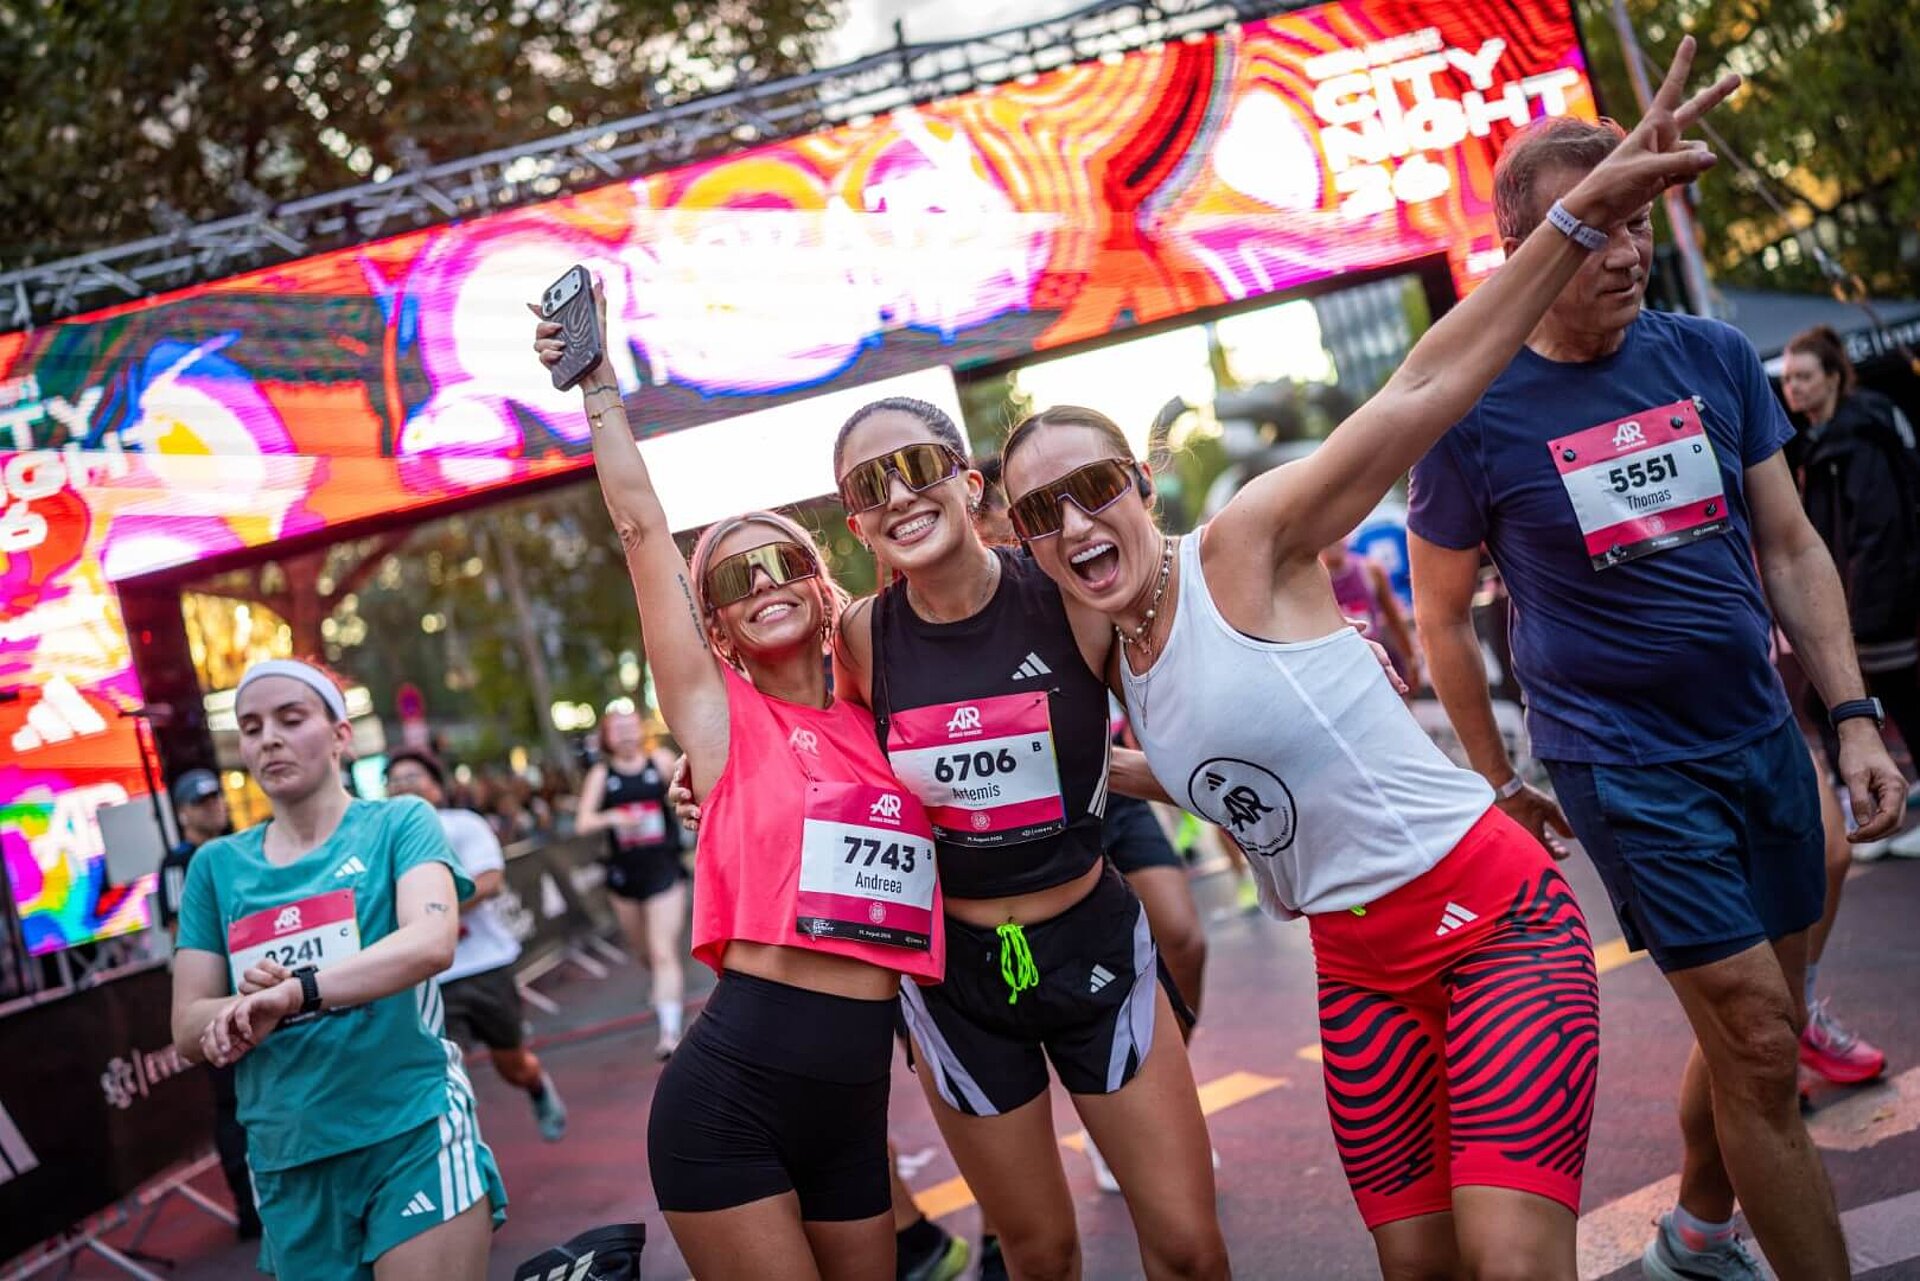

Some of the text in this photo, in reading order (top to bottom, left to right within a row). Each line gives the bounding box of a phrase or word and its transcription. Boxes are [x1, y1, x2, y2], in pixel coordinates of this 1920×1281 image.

[1312, 37, 1506, 125] CITY
[1320, 67, 1579, 172] NIGHT
[1692, 443, 1702, 454] D
[1608, 453, 1678, 493] 5551
[1626, 489, 1672, 511] Thomas
[947, 706, 983, 732] AR
[1032, 741, 1042, 752] B
[934, 748, 1017, 783] 6706
[952, 782, 1001, 801] Artemis
[869, 793, 902, 819] AR
[844, 835, 916, 874] 7743
[855, 871, 903, 894] Andreea
[340, 928, 349, 937] C
